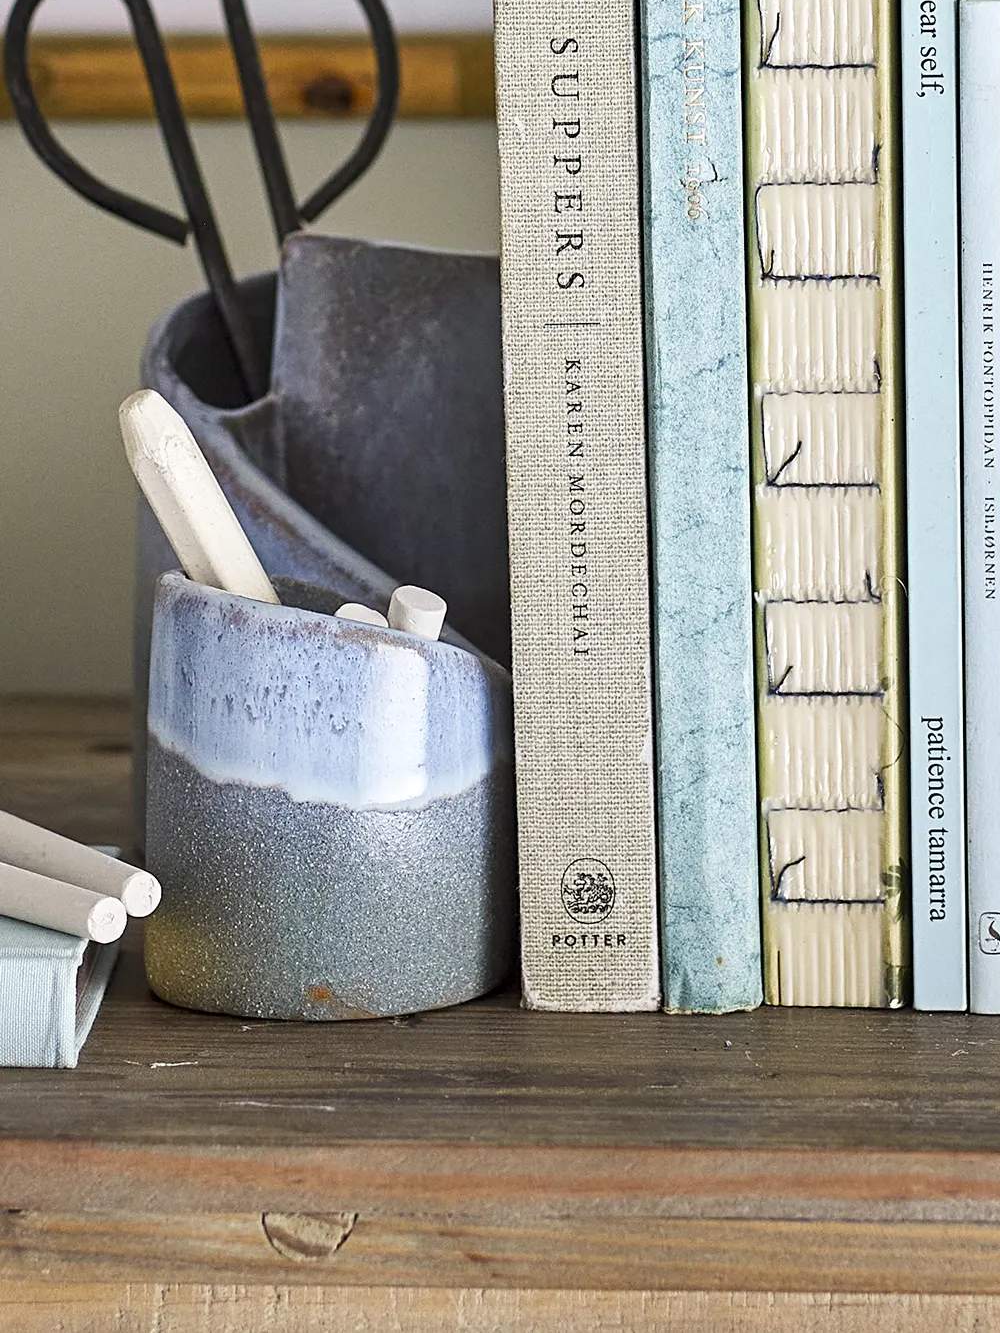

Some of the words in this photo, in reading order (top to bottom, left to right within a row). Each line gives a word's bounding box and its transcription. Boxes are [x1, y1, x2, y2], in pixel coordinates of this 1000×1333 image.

[684, 38, 707, 145] KUNST
[915, 47, 945, 98] self,
[549, 37, 586, 290] SUPPERS
[982, 263, 994, 333] HENRIK
[564, 358, 584, 459] KAREN
[983, 341, 995, 468] PONTOPPIDAN
[568, 474, 589, 657] MORDECHAI
[984, 497, 996, 600] ISBJØRNEN
[921, 716, 952, 820] patience
[928, 827, 949, 922] tamarra
[551, 934, 626, 947] POTTER
